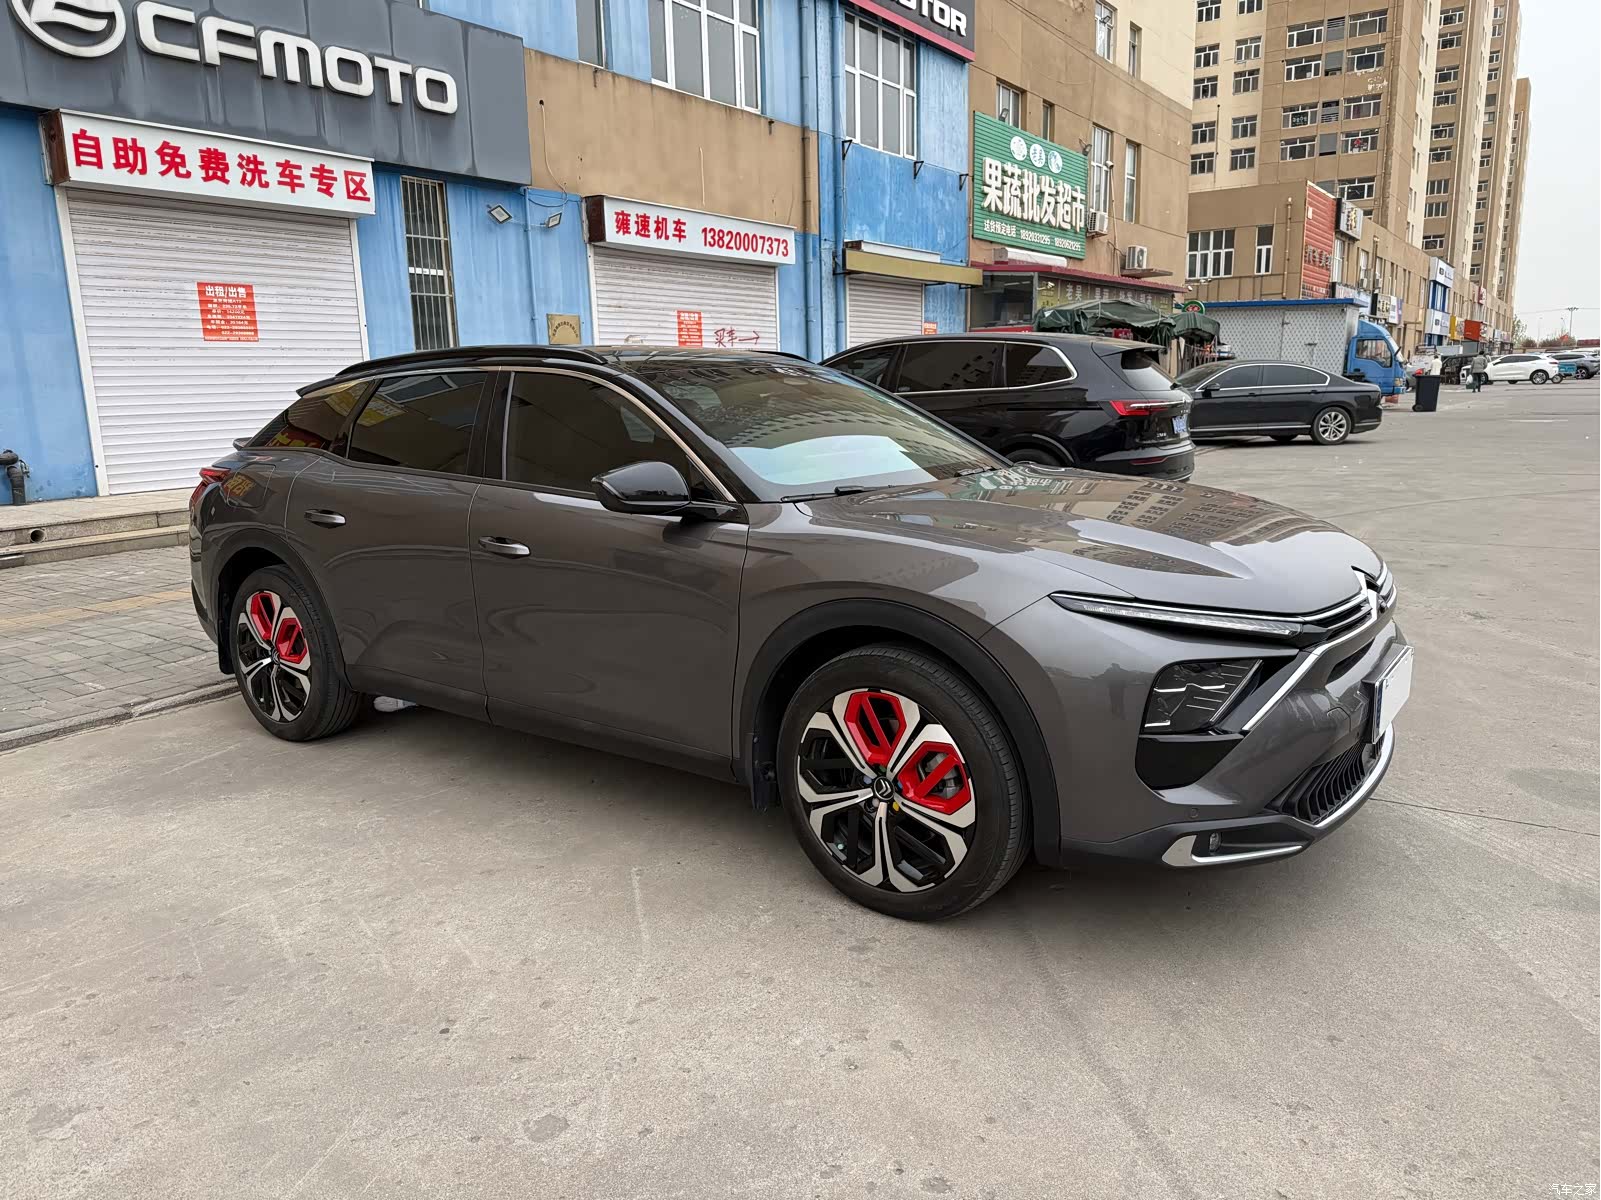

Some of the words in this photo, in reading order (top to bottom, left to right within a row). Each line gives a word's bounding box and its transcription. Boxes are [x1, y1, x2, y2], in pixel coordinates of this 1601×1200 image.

[135, 1, 458, 115] CFMOTO
[72, 129, 371, 202] 自助免费洗车专区
[982, 157, 1086, 233] 果蔬批发超市
[614, 210, 687, 243] 雍速机车
[701, 227, 789, 258] 13820007373
[205, 285, 247, 298] 出租/出售
